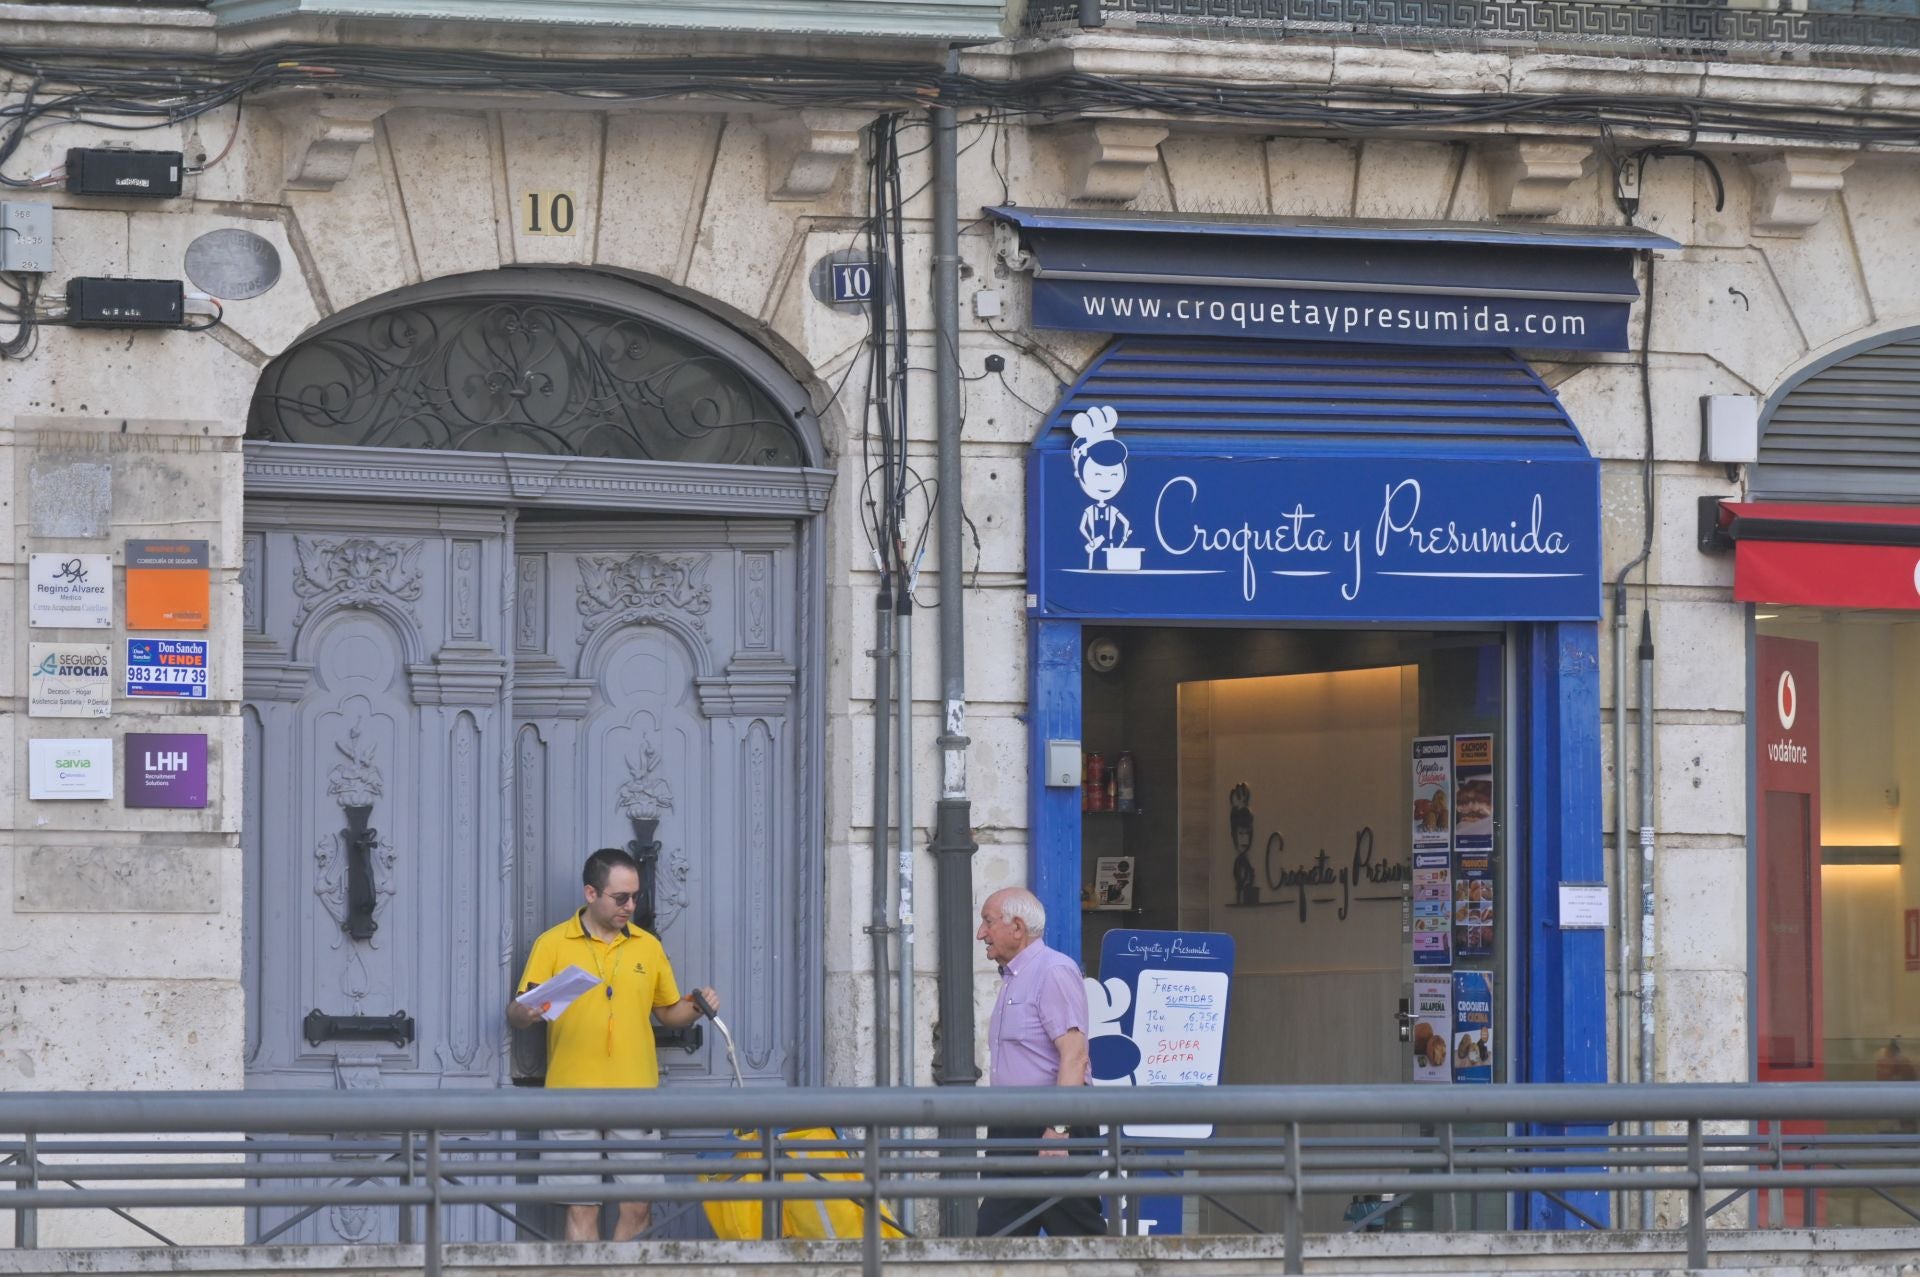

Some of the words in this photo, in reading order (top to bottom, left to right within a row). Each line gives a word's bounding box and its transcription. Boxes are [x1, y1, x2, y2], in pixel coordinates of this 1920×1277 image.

[528, 193, 574, 233] 10
[841, 266, 872, 299] 10
[1083, 295, 1587, 336] www.croquetaypresumida.com
[1154, 475, 1332, 602] Croqueta
[1341, 528, 1361, 601] y
[1376, 478, 1570, 557] Presumida
[37, 584, 69, 595] Regino
[71, 585, 105, 594] Alvarez
[158, 642, 174, 653] Don
[176, 643, 203, 654] Sancho
[59, 654, 108, 666] SEGUROS
[159, 655, 203, 666] VENDE
[58, 665, 109, 677] ATOCHA
[128, 667, 150, 681] 983
[154, 668, 168, 682] 21
[173, 668, 187, 682] 77
[191, 669, 206, 683] 39
[76, 688, 92, 697] Hogar
[1767, 738, 1808, 764] vodafone
[145, 752, 188, 771] LHH
[1338, 866, 1349, 921] y
[1128, 936, 1163, 961] Croqueta
[1171, 938, 1210, 955] Presumida
[1457, 1001, 1489, 1012] CROQUETA
[1458, 1012, 1467, 1022] DE
[1158, 1039, 1200, 1052] SUPER
[1147, 1053, 1194, 1065] OFERTA
